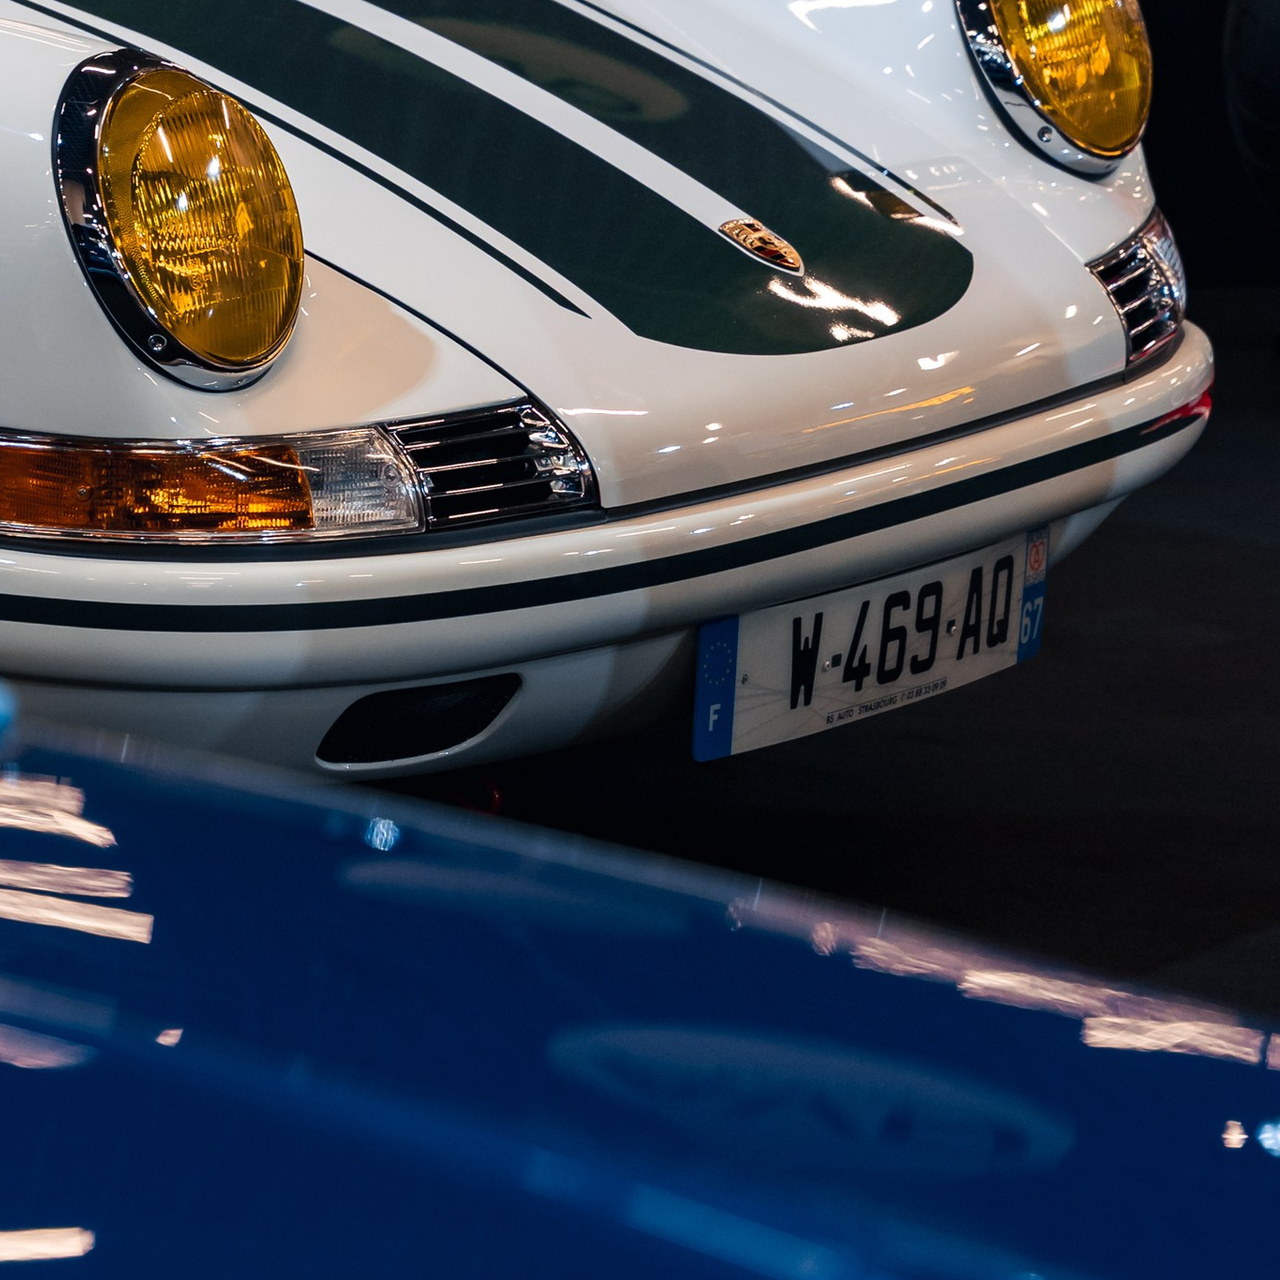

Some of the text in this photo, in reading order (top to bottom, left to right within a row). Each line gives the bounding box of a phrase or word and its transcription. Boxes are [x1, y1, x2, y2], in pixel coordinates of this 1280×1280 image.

[789, 554, 1014, 710] W-469-AQ
[1021, 596, 1044, 644] 67
[708, 704, 721, 732] F
[837, 709, 854, 722] AUTO
[858, 695, 898, 715] STRASBOURG
